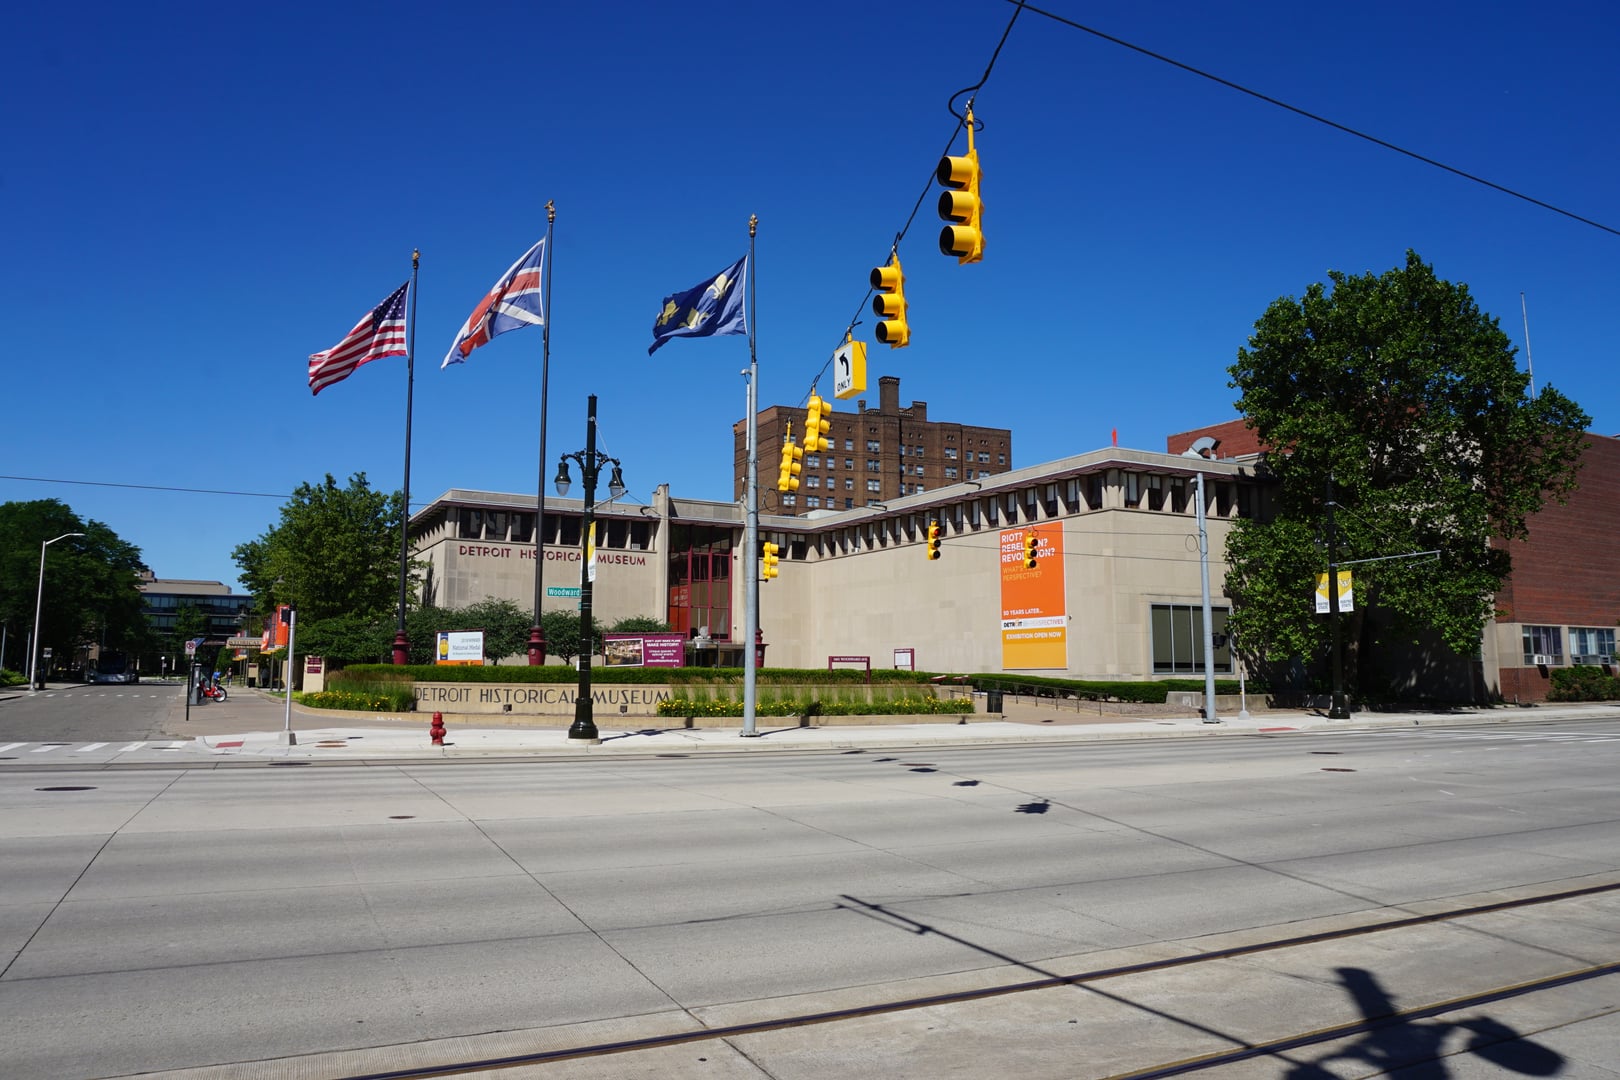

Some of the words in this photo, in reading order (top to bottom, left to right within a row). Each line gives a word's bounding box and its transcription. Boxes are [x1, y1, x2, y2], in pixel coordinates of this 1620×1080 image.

[837, 377, 851, 392] ONLY
[1001, 532, 1022, 543] RIOT?
[1001, 538, 1048, 553] REBELN?
[459, 545, 512, 558] DETROIT
[520, 548, 581, 561] HISTORICA
[597, 554, 646, 566] MUSEUM
[548, 588, 581, 597] Woodward
[414, 687, 472, 702] DETROIT
[479, 688, 579, 704] HISTORICAL
[592, 689, 671, 705] MUSEUM
